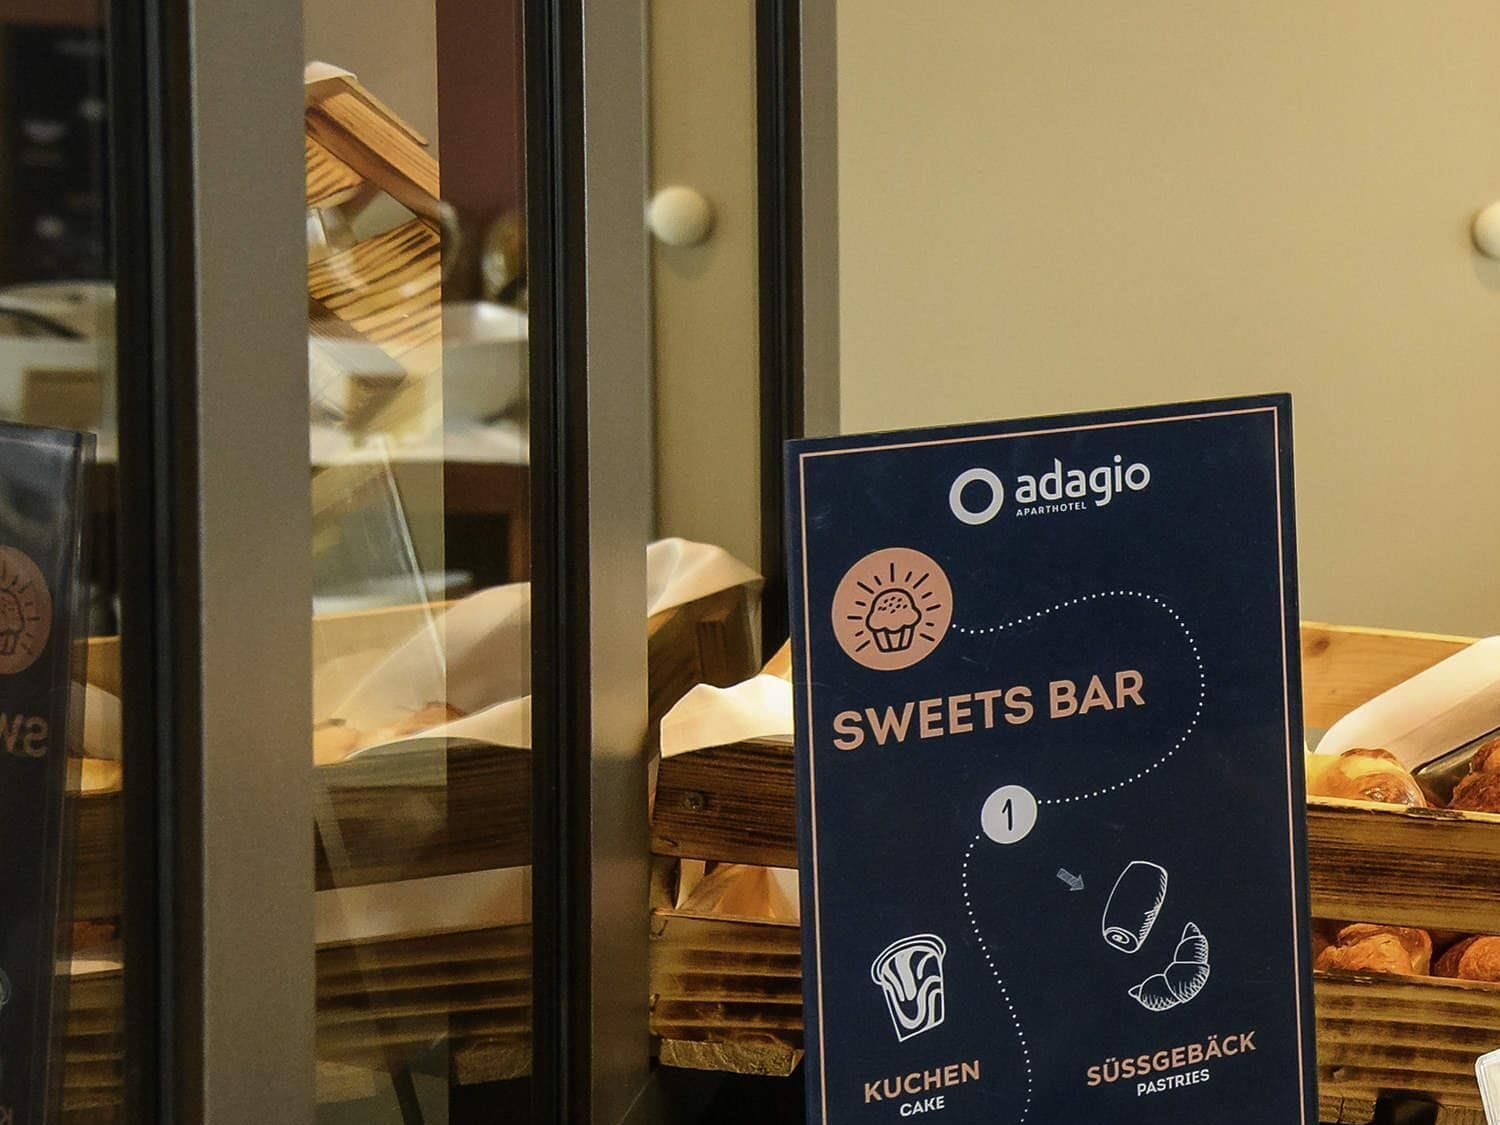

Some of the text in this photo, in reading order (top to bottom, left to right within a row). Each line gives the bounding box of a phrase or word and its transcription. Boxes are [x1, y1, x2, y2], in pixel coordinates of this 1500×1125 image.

[1015, 454, 1151, 507] adagio
[1015, 501, 1088, 518] APARTHOTEL
[832, 669, 1146, 751] SWEETS BAR
[1086, 1030, 1257, 1087] SÜSSGEBÄCK
[863, 1059, 980, 1104] KUCHEN
[1136, 1068, 1211, 1097] PASTRIES
[899, 1095, 945, 1117] CAKE
